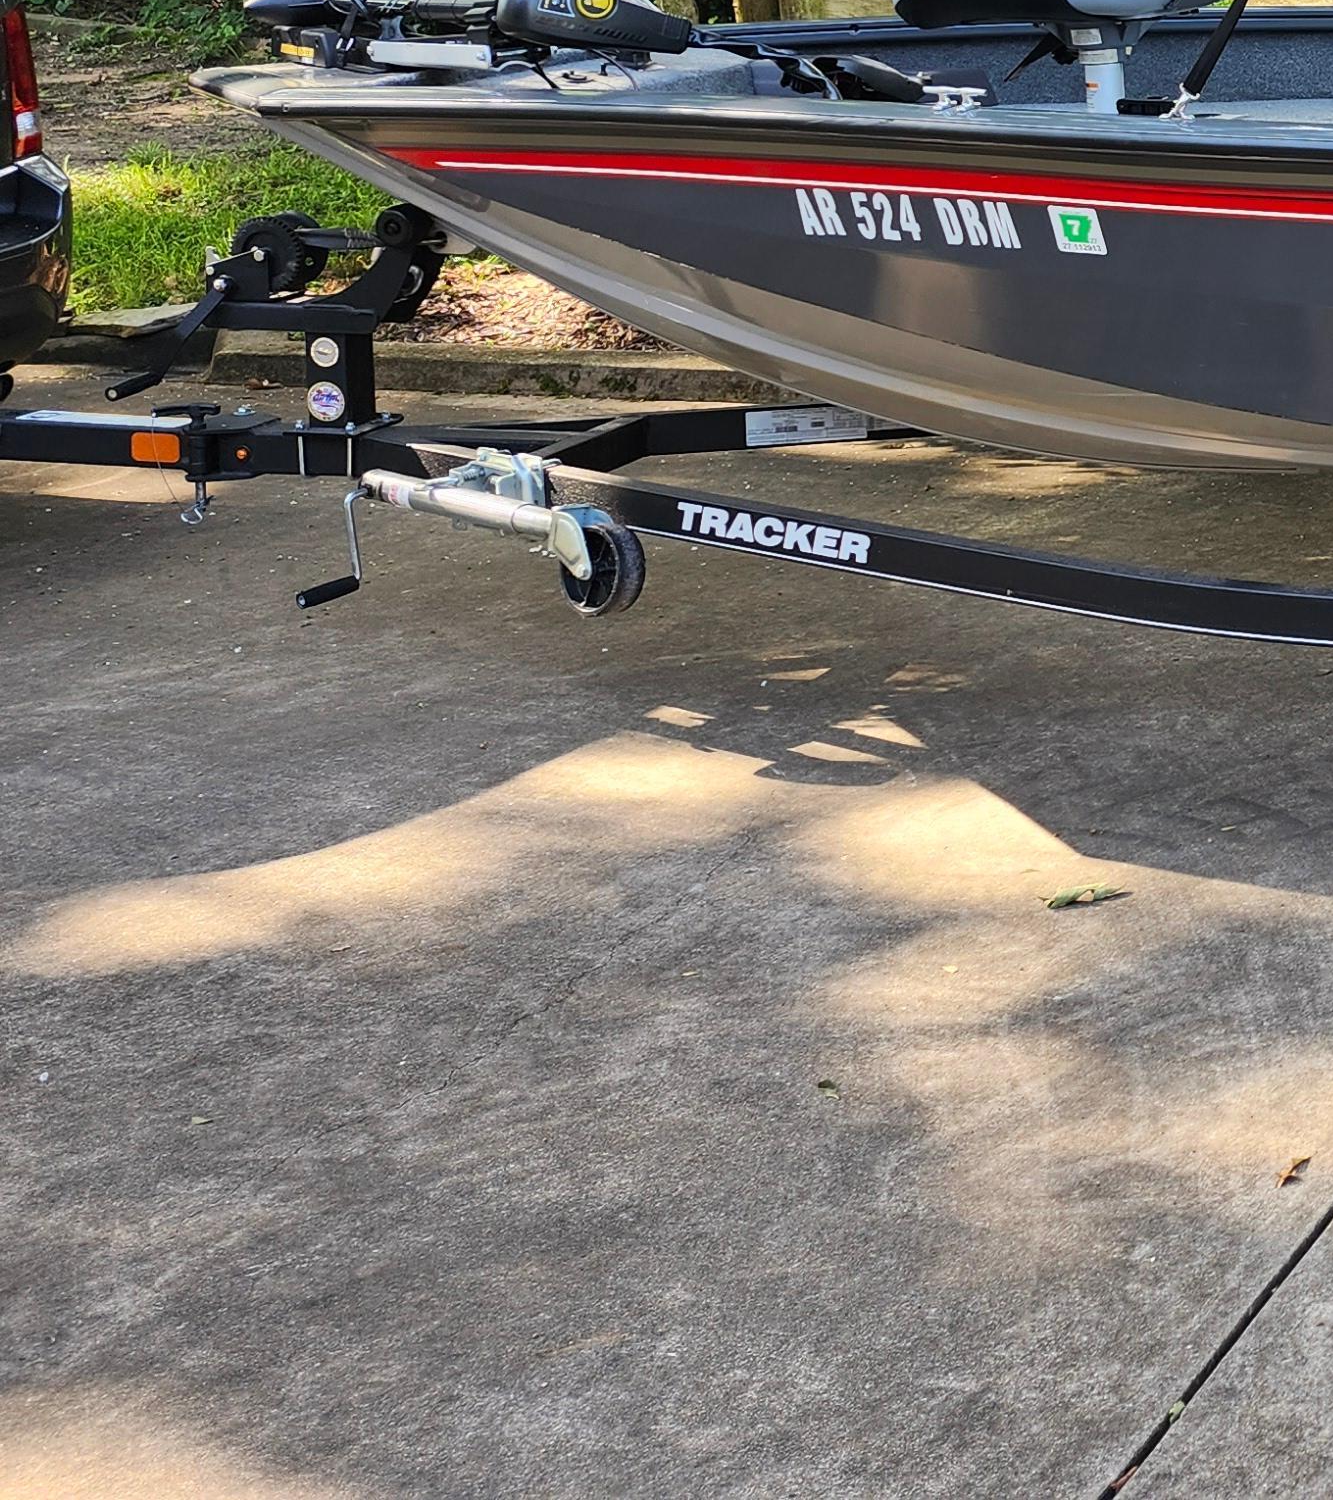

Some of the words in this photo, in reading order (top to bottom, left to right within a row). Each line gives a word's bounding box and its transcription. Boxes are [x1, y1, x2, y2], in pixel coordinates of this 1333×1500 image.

[796, 188, 846, 236] AR
[850, 191, 921, 241] 524
[933, 197, 1022, 249] DRM
[1066, 219, 1080, 236] 7
[677, 502, 871, 564] TRACKER
